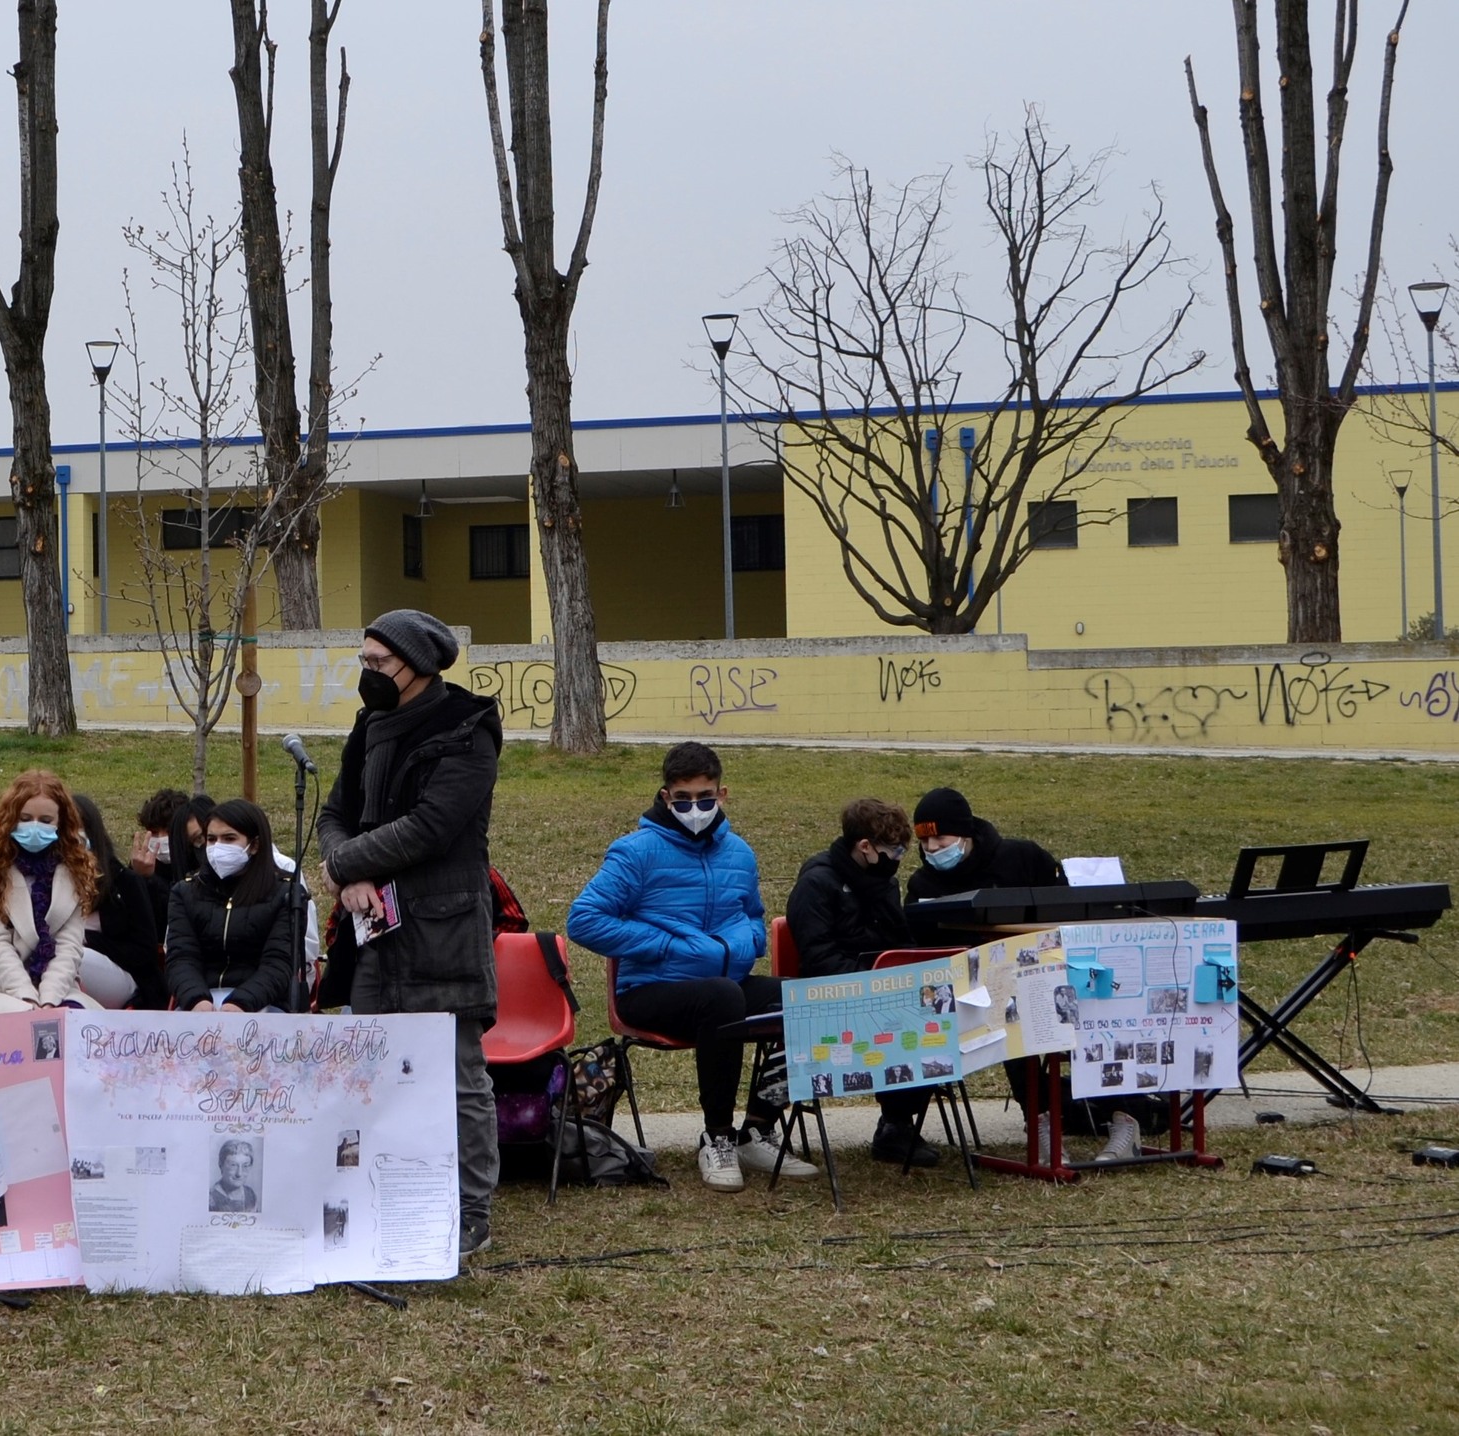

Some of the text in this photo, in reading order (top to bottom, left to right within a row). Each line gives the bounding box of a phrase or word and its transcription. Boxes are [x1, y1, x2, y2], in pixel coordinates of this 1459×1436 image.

[1109, 436, 1193, 452] Parrocchia
[1140, 457, 1175, 471] della
[1181, 453, 1239, 469] Fiducia
[470, 661, 637, 728] BLOD
[689, 664, 777, 716] RISE
[1183, 923, 1225, 940] SERRA
[807, 981, 863, 1000] DIRITTI
[871, 974, 914, 992] DELLE
[922, 964, 964, 985] DONNE
[81, 1019, 390, 1074] Bianca Guidetti
[197, 1070, 295, 1114] Serra
